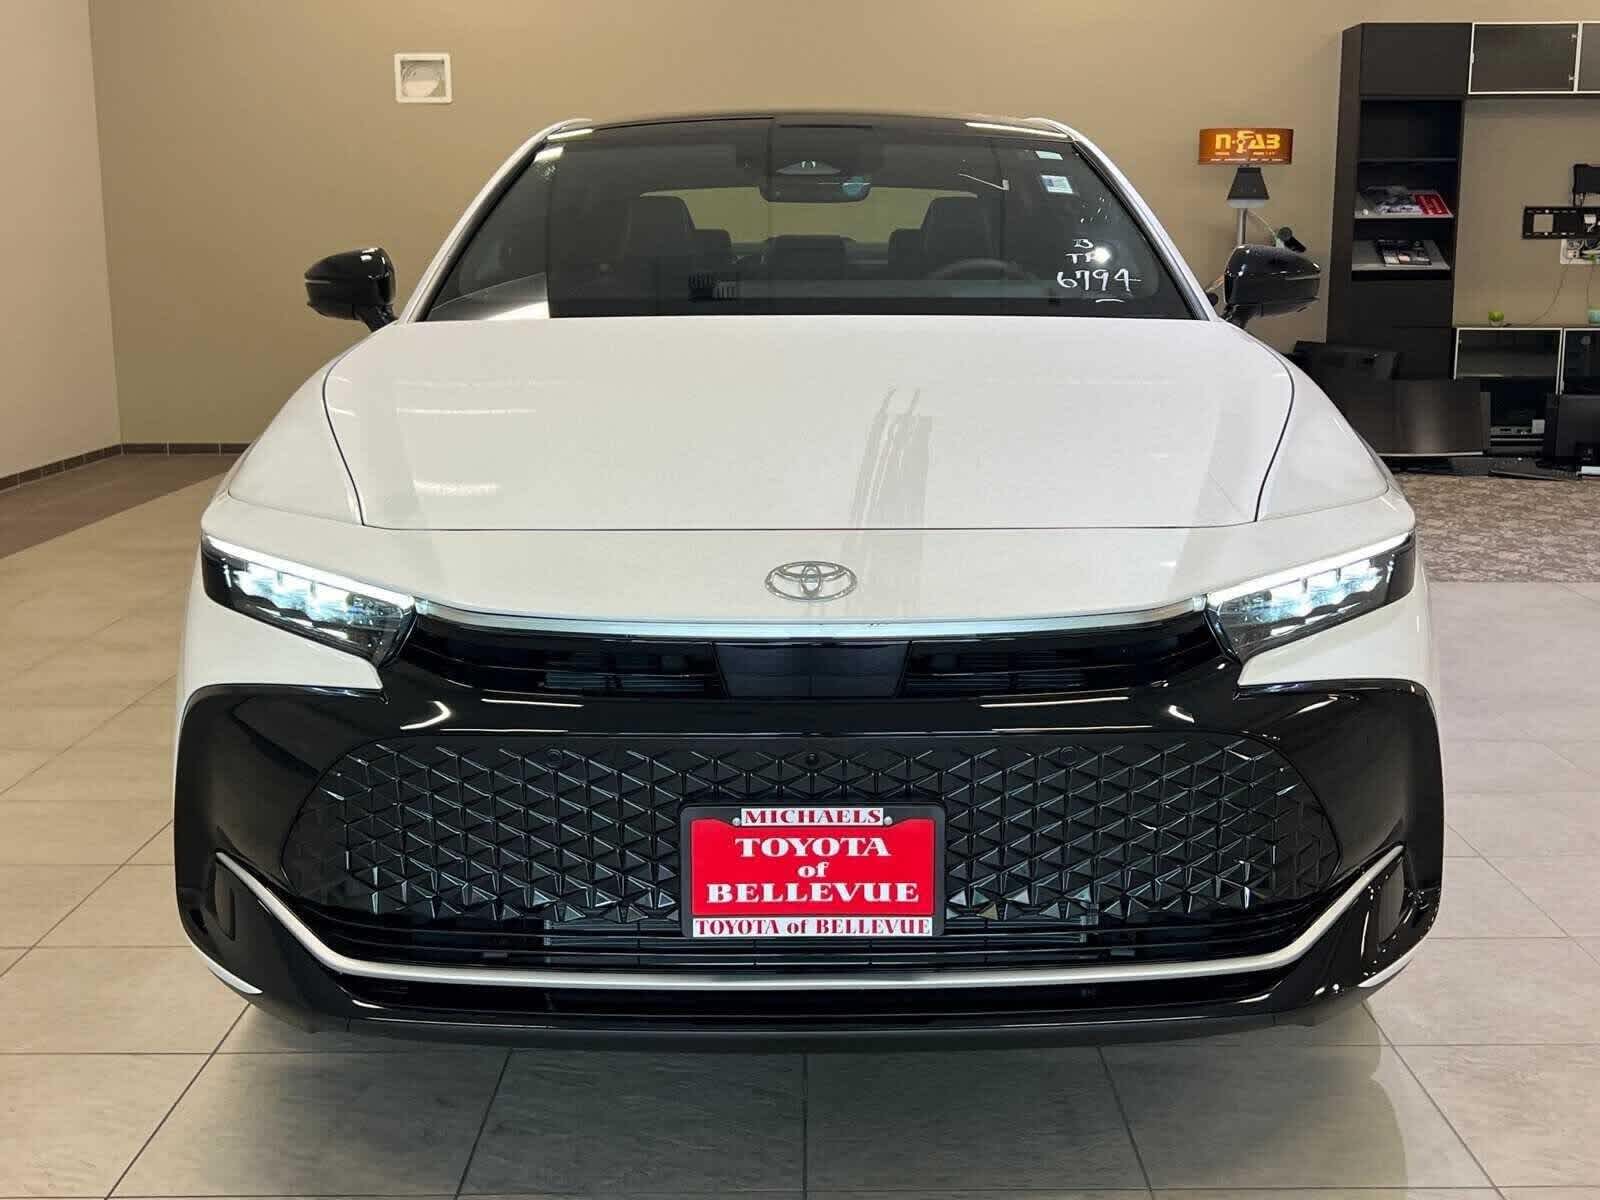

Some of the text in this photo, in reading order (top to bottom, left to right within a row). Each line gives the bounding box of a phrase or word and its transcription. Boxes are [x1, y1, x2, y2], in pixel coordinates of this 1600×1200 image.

[1056, 268, 1142, 291] 6794
[744, 809, 882, 824] MICHAELS
[735, 837, 890, 857] TOYOTA
[797, 861, 829, 878] of
[706, 882, 920, 904] BELLEVUE
[696, 918, 931, 935] TOYOTA of BELLEVUE
